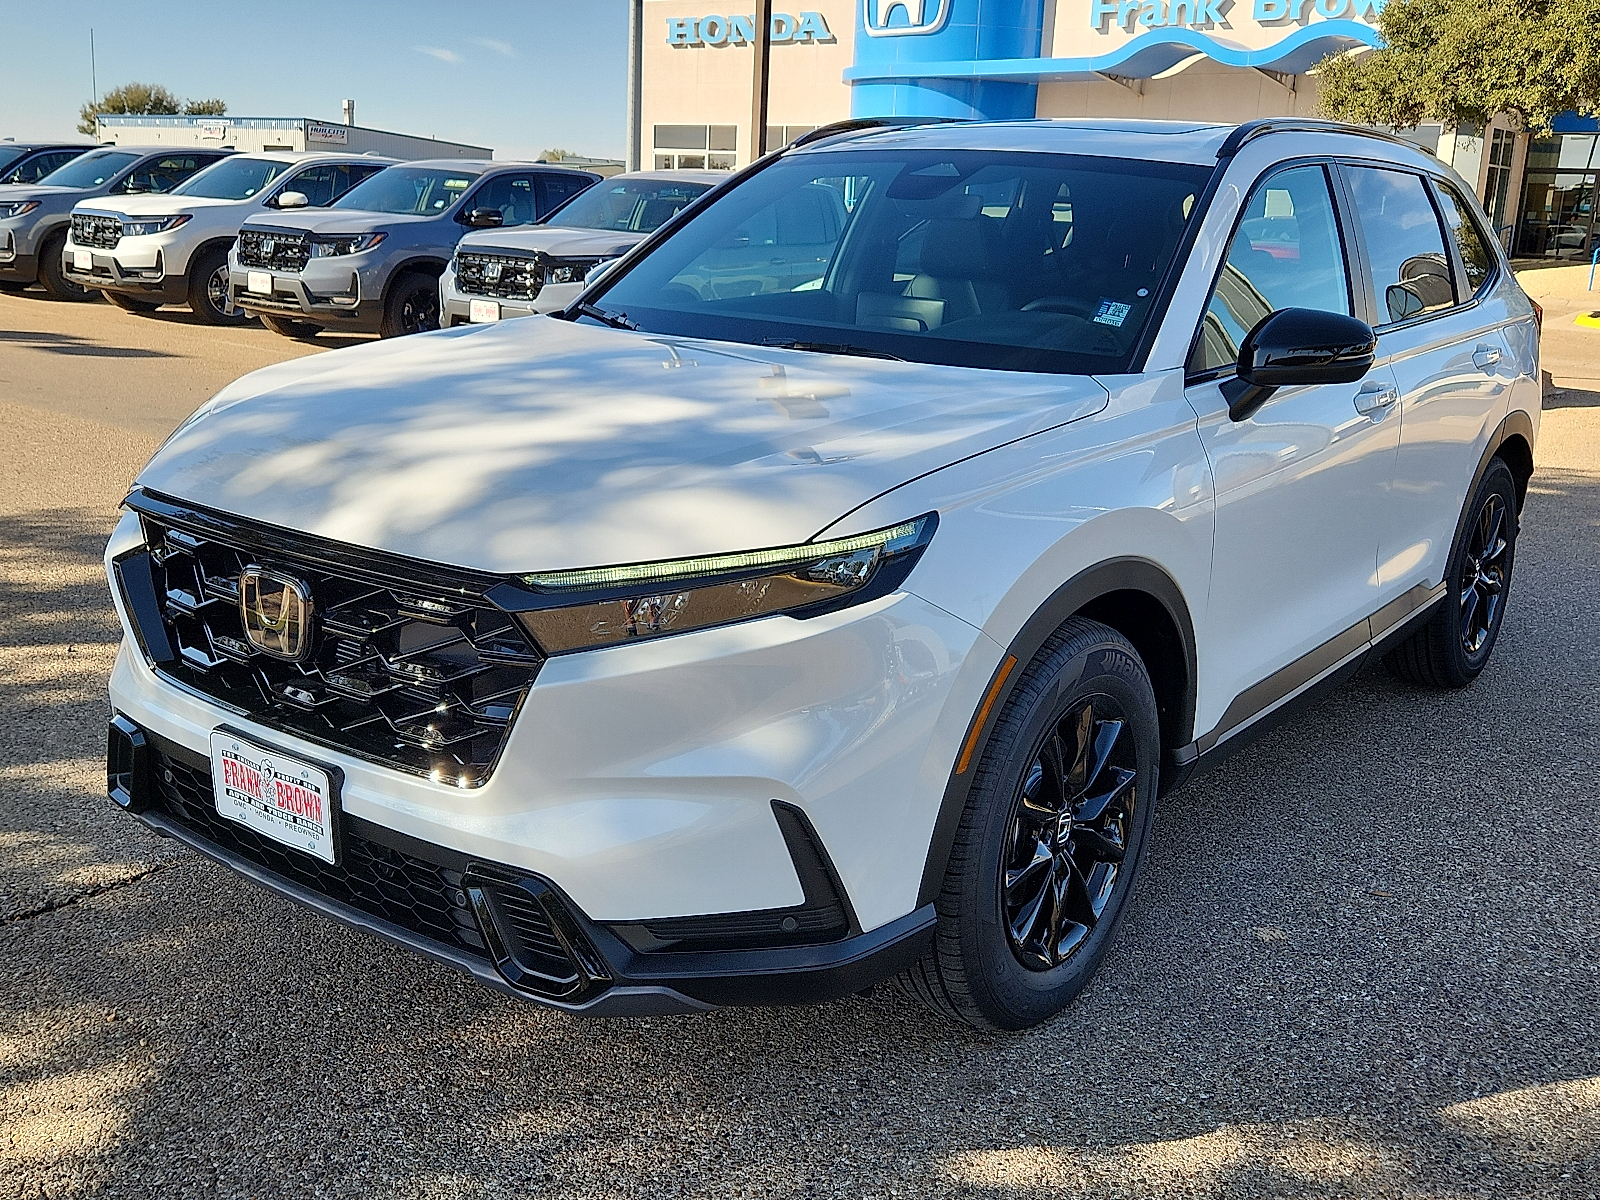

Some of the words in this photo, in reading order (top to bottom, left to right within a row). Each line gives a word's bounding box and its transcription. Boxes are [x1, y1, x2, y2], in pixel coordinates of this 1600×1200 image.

[666, 11, 833, 44] HONDA
[1090, 0, 1225, 28] Frank
[1253, 0, 1386, 20] Brow
[222, 758, 263, 800] FRANK
[276, 780, 322, 824] BROWN
[229, 790, 249, 802] AUTO
[251, 800, 265, 811] AND
[268, 807, 293, 822] TRUCK
[297, 817, 323, 834] RANCH
[234, 800, 247, 810] GMC
[255, 809, 274, 823] HONDA
[285, 822, 320, 841] PREOWNED
